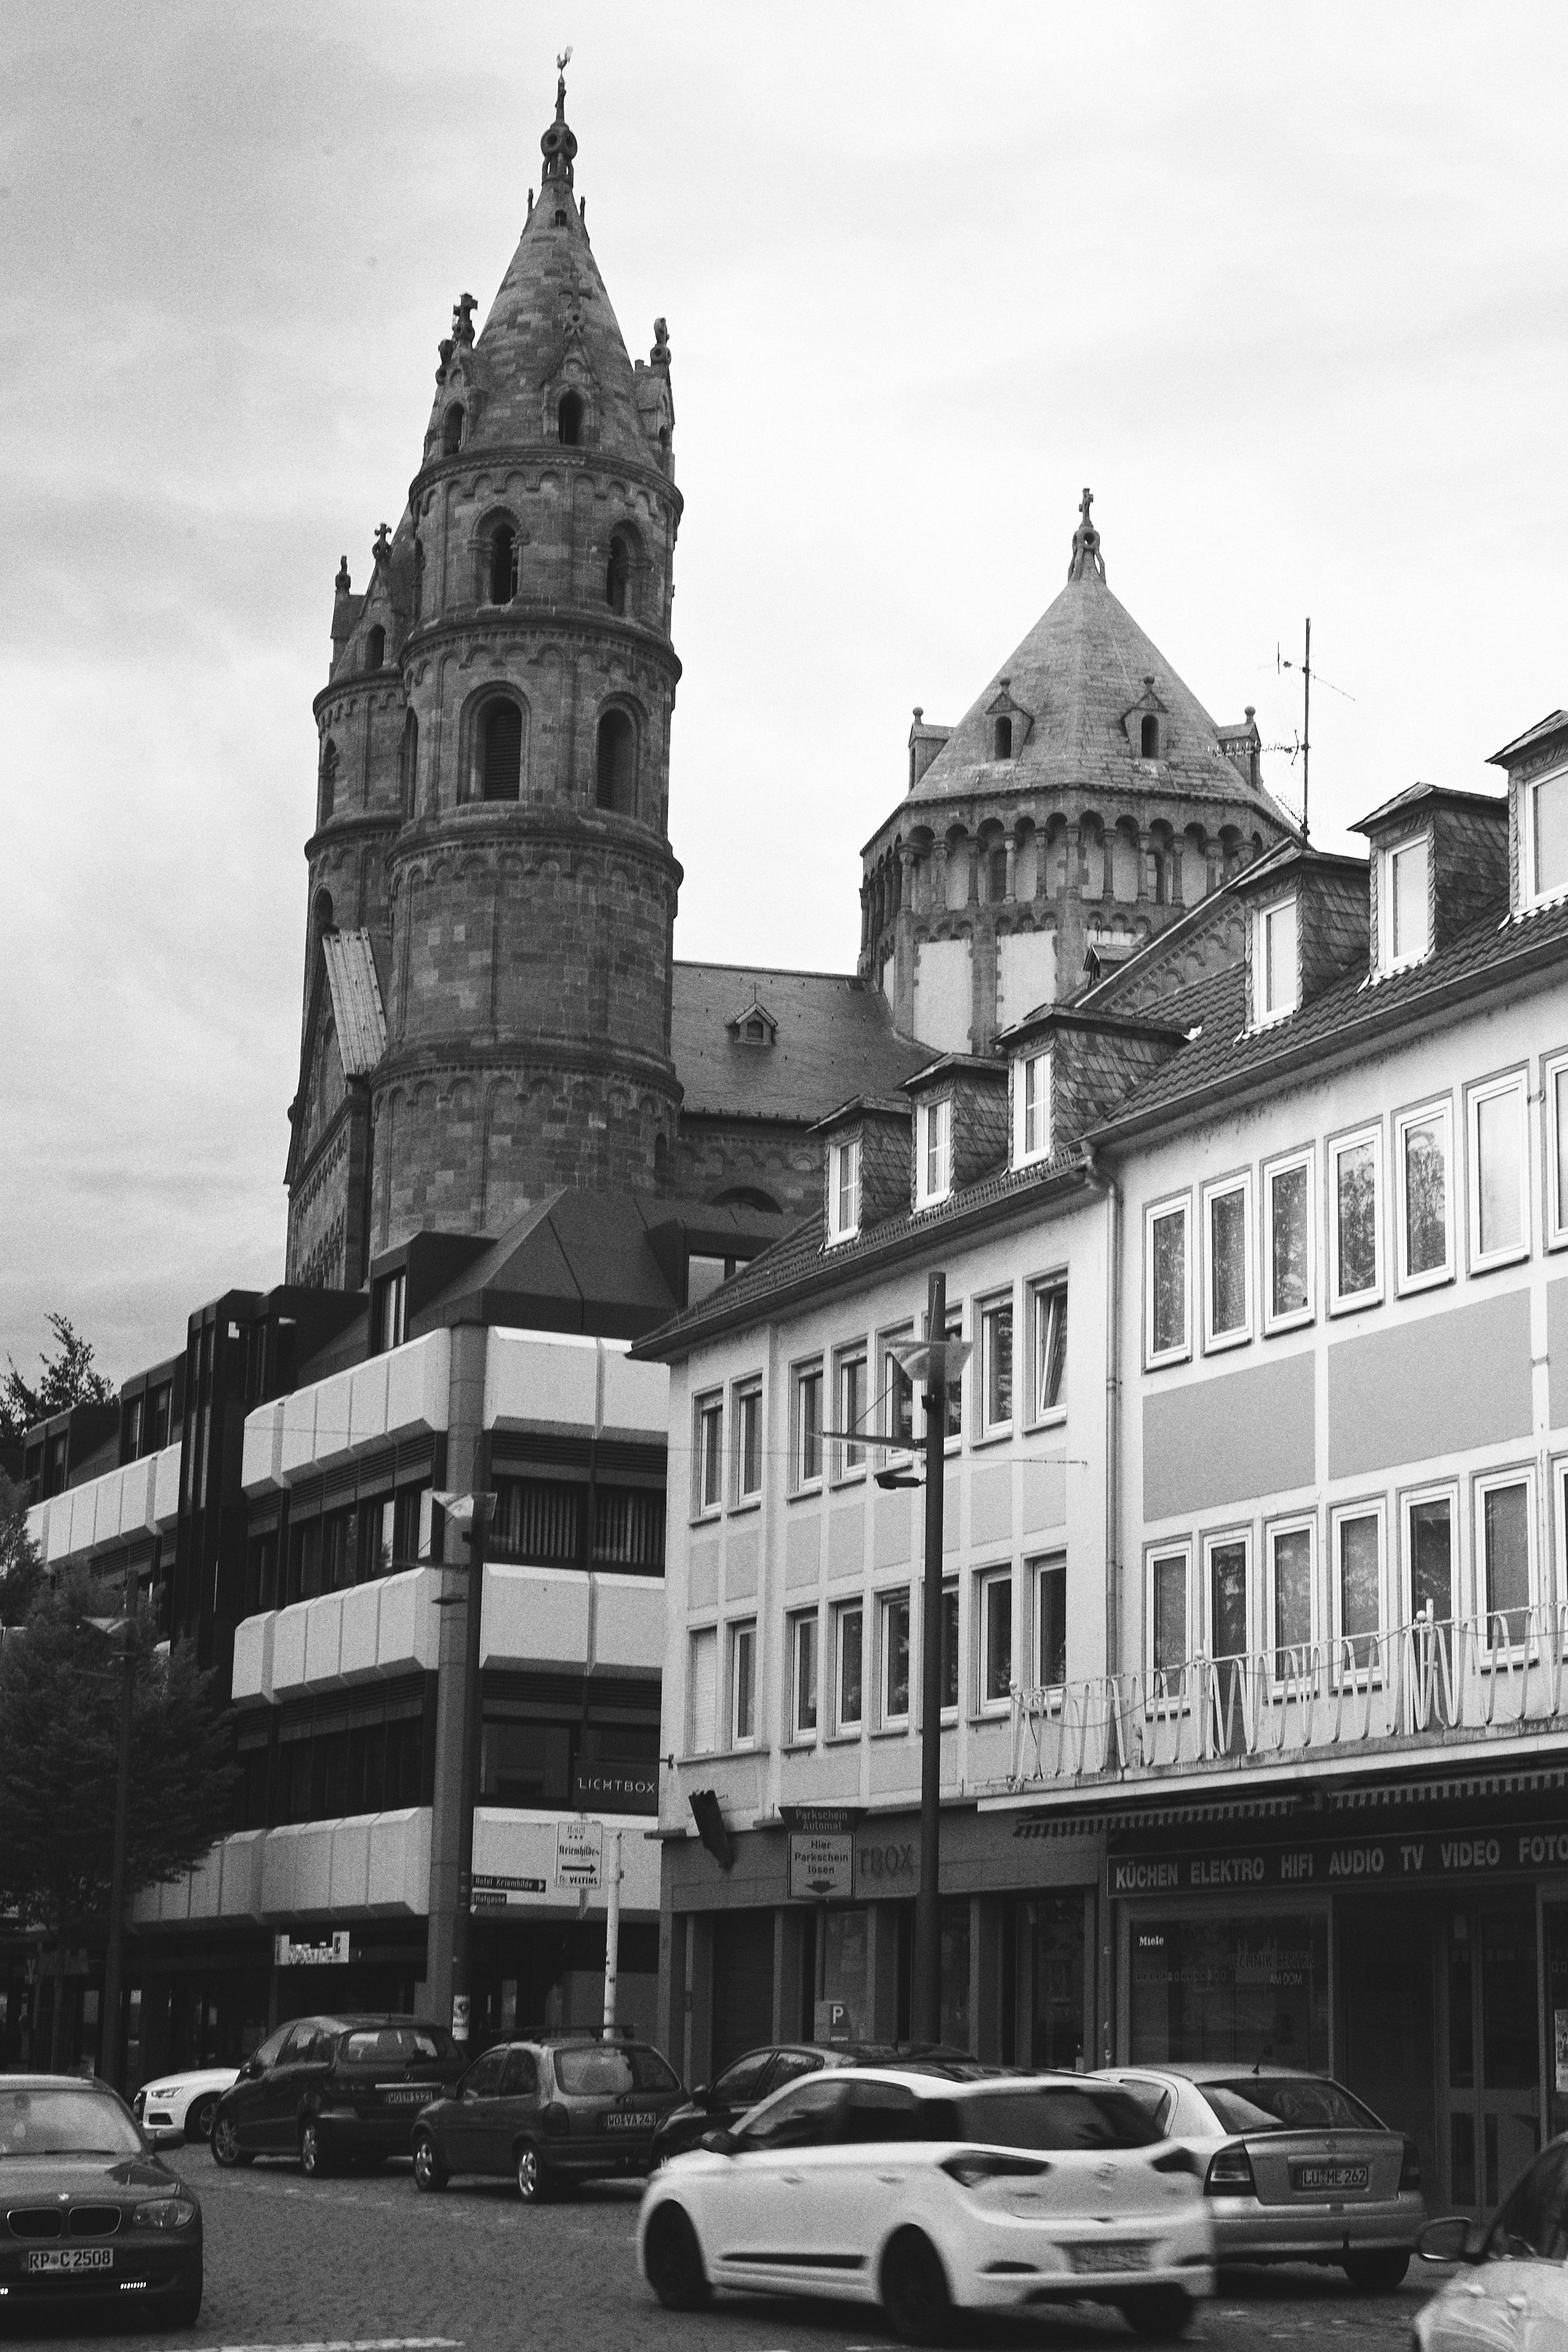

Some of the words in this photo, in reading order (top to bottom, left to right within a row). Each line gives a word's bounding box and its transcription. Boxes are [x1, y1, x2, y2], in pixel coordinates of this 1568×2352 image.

[577, 1777, 655, 1794] LICHTBOX
[795, 1808, 848, 1820] Parkschein
[803, 1820, 842, 1831] Automat
[811, 1839, 831, 1849] Hier
[794, 1851, 848, 1862] Parkschein
[808, 1864, 835, 1875] lösen
[1116, 1860, 1178, 1889] KÜCHEN
[1190, 1856, 1264, 1884] ELEKTRO
[1280, 1853, 1313, 1878] HIFI
[1328, 1847, 1385, 1875] AUDIO
[1399, 1844, 1424, 1871] TV
[1440, 1838, 1500, 1868] VIDEO
[475, 1875, 493, 1886] Hotel
[496, 1876, 533, 1889] Kriemhilde
[570, 1876, 597, 1885] VELTINS
[475, 1893, 506, 1906] Hofgasse
[1139, 1935, 1164, 1947] Miele
[1229, 1951, 1272, 1969] TECHNIK
[1269, 1973, 1282, 1985] AM
[1283, 1973, 1302, 1985] DOM
[833, 2005, 844, 2024] P
[1304, 2170, 1319, 2184] LU
[1327, 2170, 1341, 2183] ME
[1344, 2169, 1366, 2183] 262
[30, 2253, 49, 2268] RP
[60, 2251, 70, 2267] C
[73, 2250, 111, 2267] 2508
